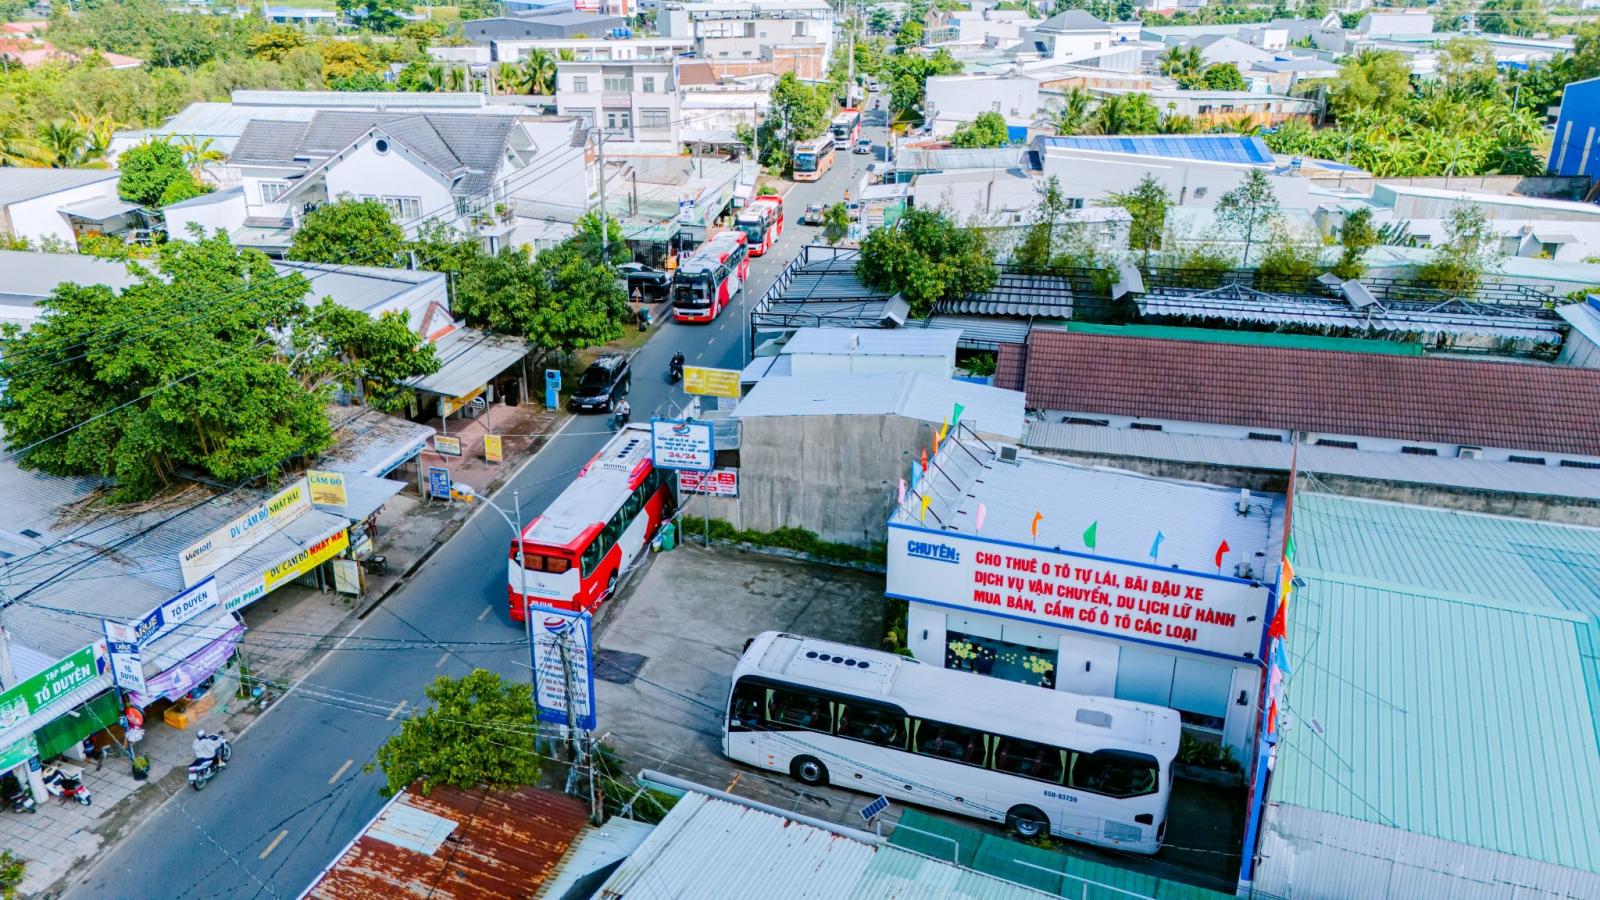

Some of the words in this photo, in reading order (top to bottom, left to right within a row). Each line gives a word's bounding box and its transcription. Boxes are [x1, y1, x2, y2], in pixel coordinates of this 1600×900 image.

[907, 540, 960, 562] CHUYÊN:
[976, 551, 1001, 567] CHO
[1006, 556, 1038, 573] THUÊ
[1054, 563, 1071, 579] TÔ
[1075, 567, 1093, 584] TỰ
[1095, 571, 1120, 588] LÁI,
[1124, 576, 1148, 592] BÃI
[1152, 580, 1181, 597] ĐẬU
[1184, 586, 1204, 601] XE
[974, 590, 1002, 606] MUA
[1007, 596, 1036, 614] BÁN,
[1079, 606, 1098, 623] CỐ
[1100, 610, 1109, 625] Ô
[1135, 618, 1162, 635] CÁC
[1166, 624, 1198, 643] LOẠI
[975, 571, 1004, 587] DỊCH
[1008, 576, 1024, 593] VỤ
[1029, 579, 1053, 596] VẬN
[1057, 585, 1112, 607] CHUYỂN,
[1117, 595, 1135, 609] DU
[1138, 599, 1169, 616] LỊCH
[1173, 603, 1192, 619] LỮ
[1195, 607, 1236, 627] HÀNH
[34, 683, 51, 705] TỐ
[52, 664, 91, 695] DUYÊN
[45, 669, 59, 682] TẠP
[60, 661, 75, 673] HÓA
